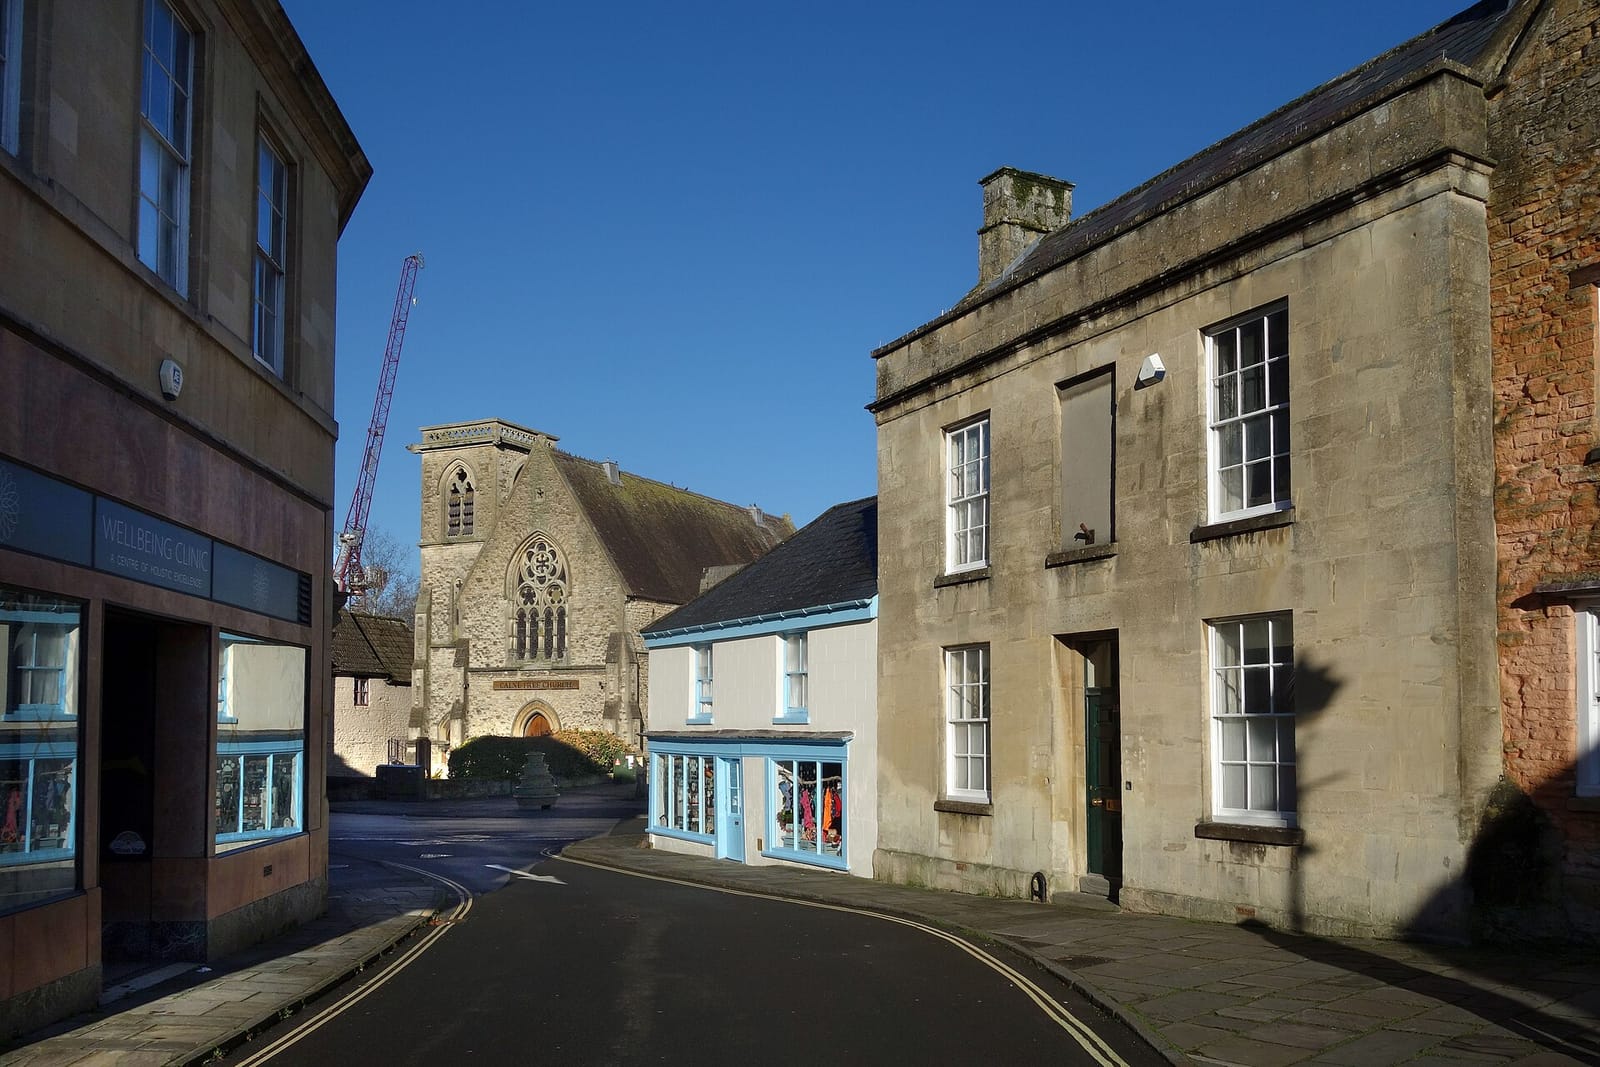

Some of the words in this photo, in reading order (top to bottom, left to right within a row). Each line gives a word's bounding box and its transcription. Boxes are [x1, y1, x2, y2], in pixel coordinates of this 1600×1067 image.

[102, 514, 173, 560] WELLBEING
[175, 542, 208, 572] CLINIC
[117, 555, 139, 571] CENTRE
[140, 562, 149, 572] OF
[150, 566, 173, 580] HOLISTIC
